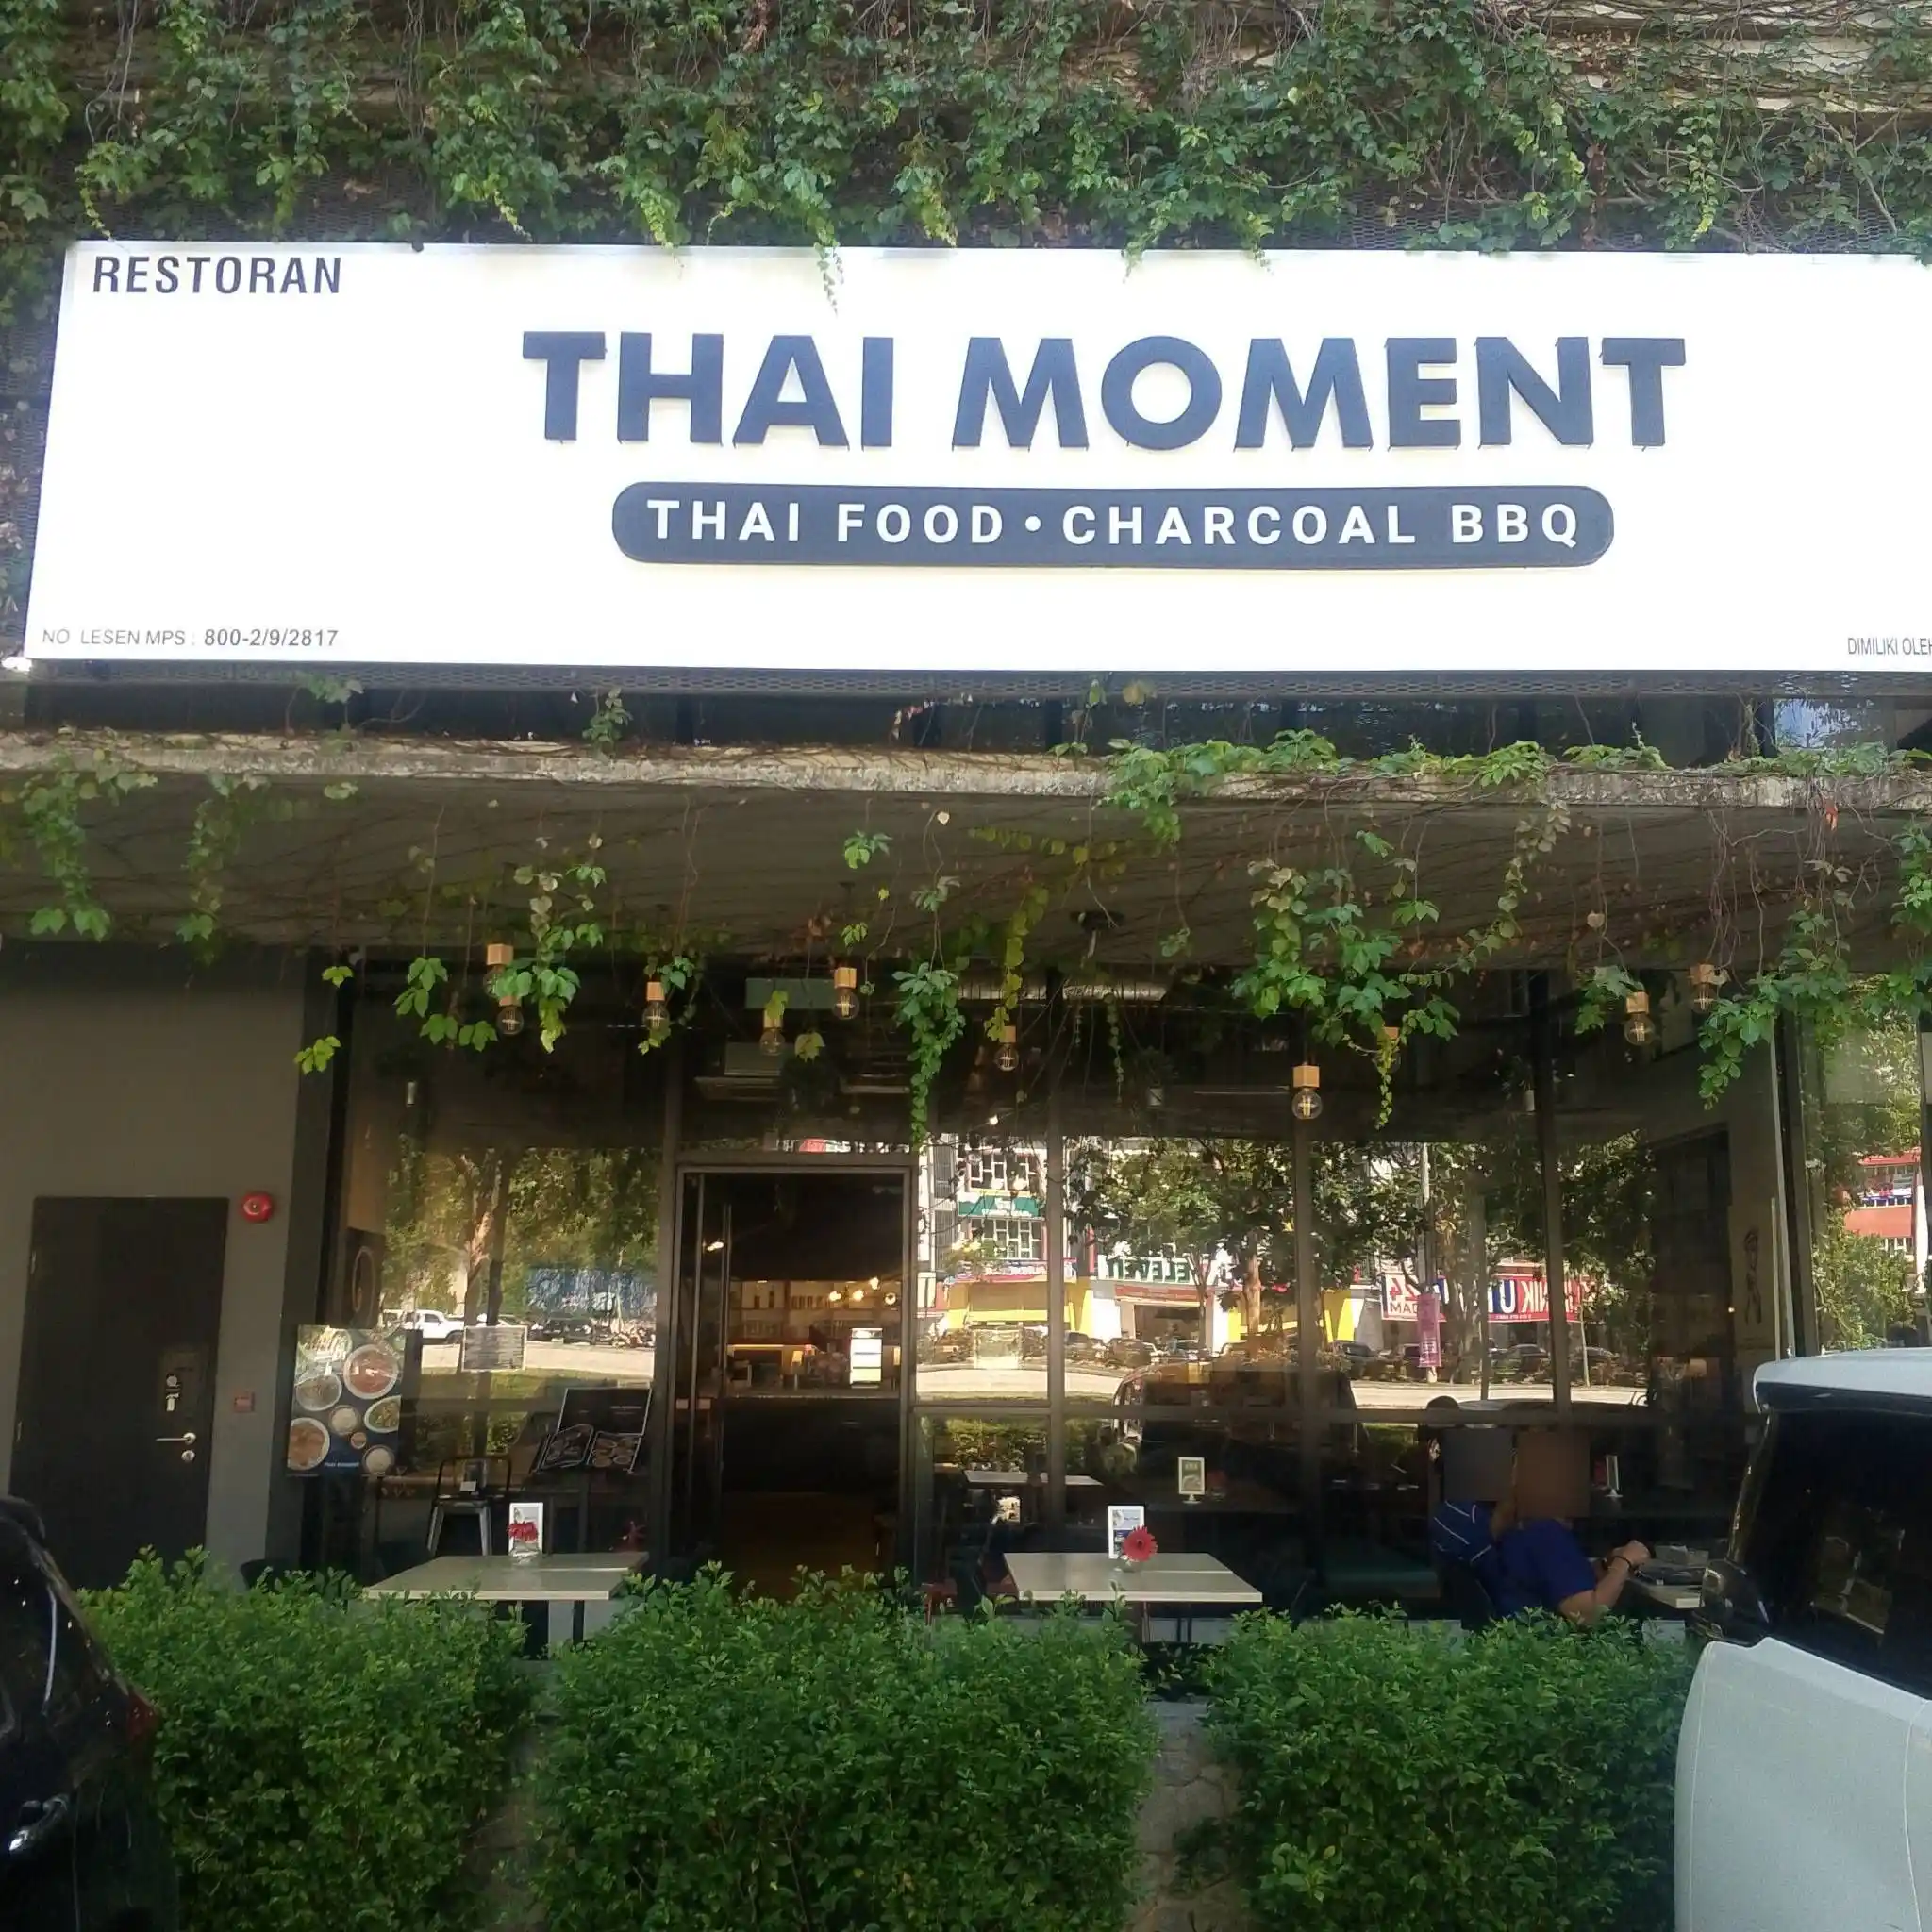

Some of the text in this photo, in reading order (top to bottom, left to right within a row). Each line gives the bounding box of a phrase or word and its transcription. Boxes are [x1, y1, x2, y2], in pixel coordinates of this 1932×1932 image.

[92, 256, 341, 294] RESTORAN
[522, 330, 1686, 451] THAI MOMENT
[646, 499, 1579, 549] THAI FOOD CHARCOAL BBQ
[42, 628, 70, 645] NO
[80, 628, 140, 645] LESEN
[203, 627, 339, 647] 800-2/9/2817
[1847, 636, 1899, 656] DIMILIKI
